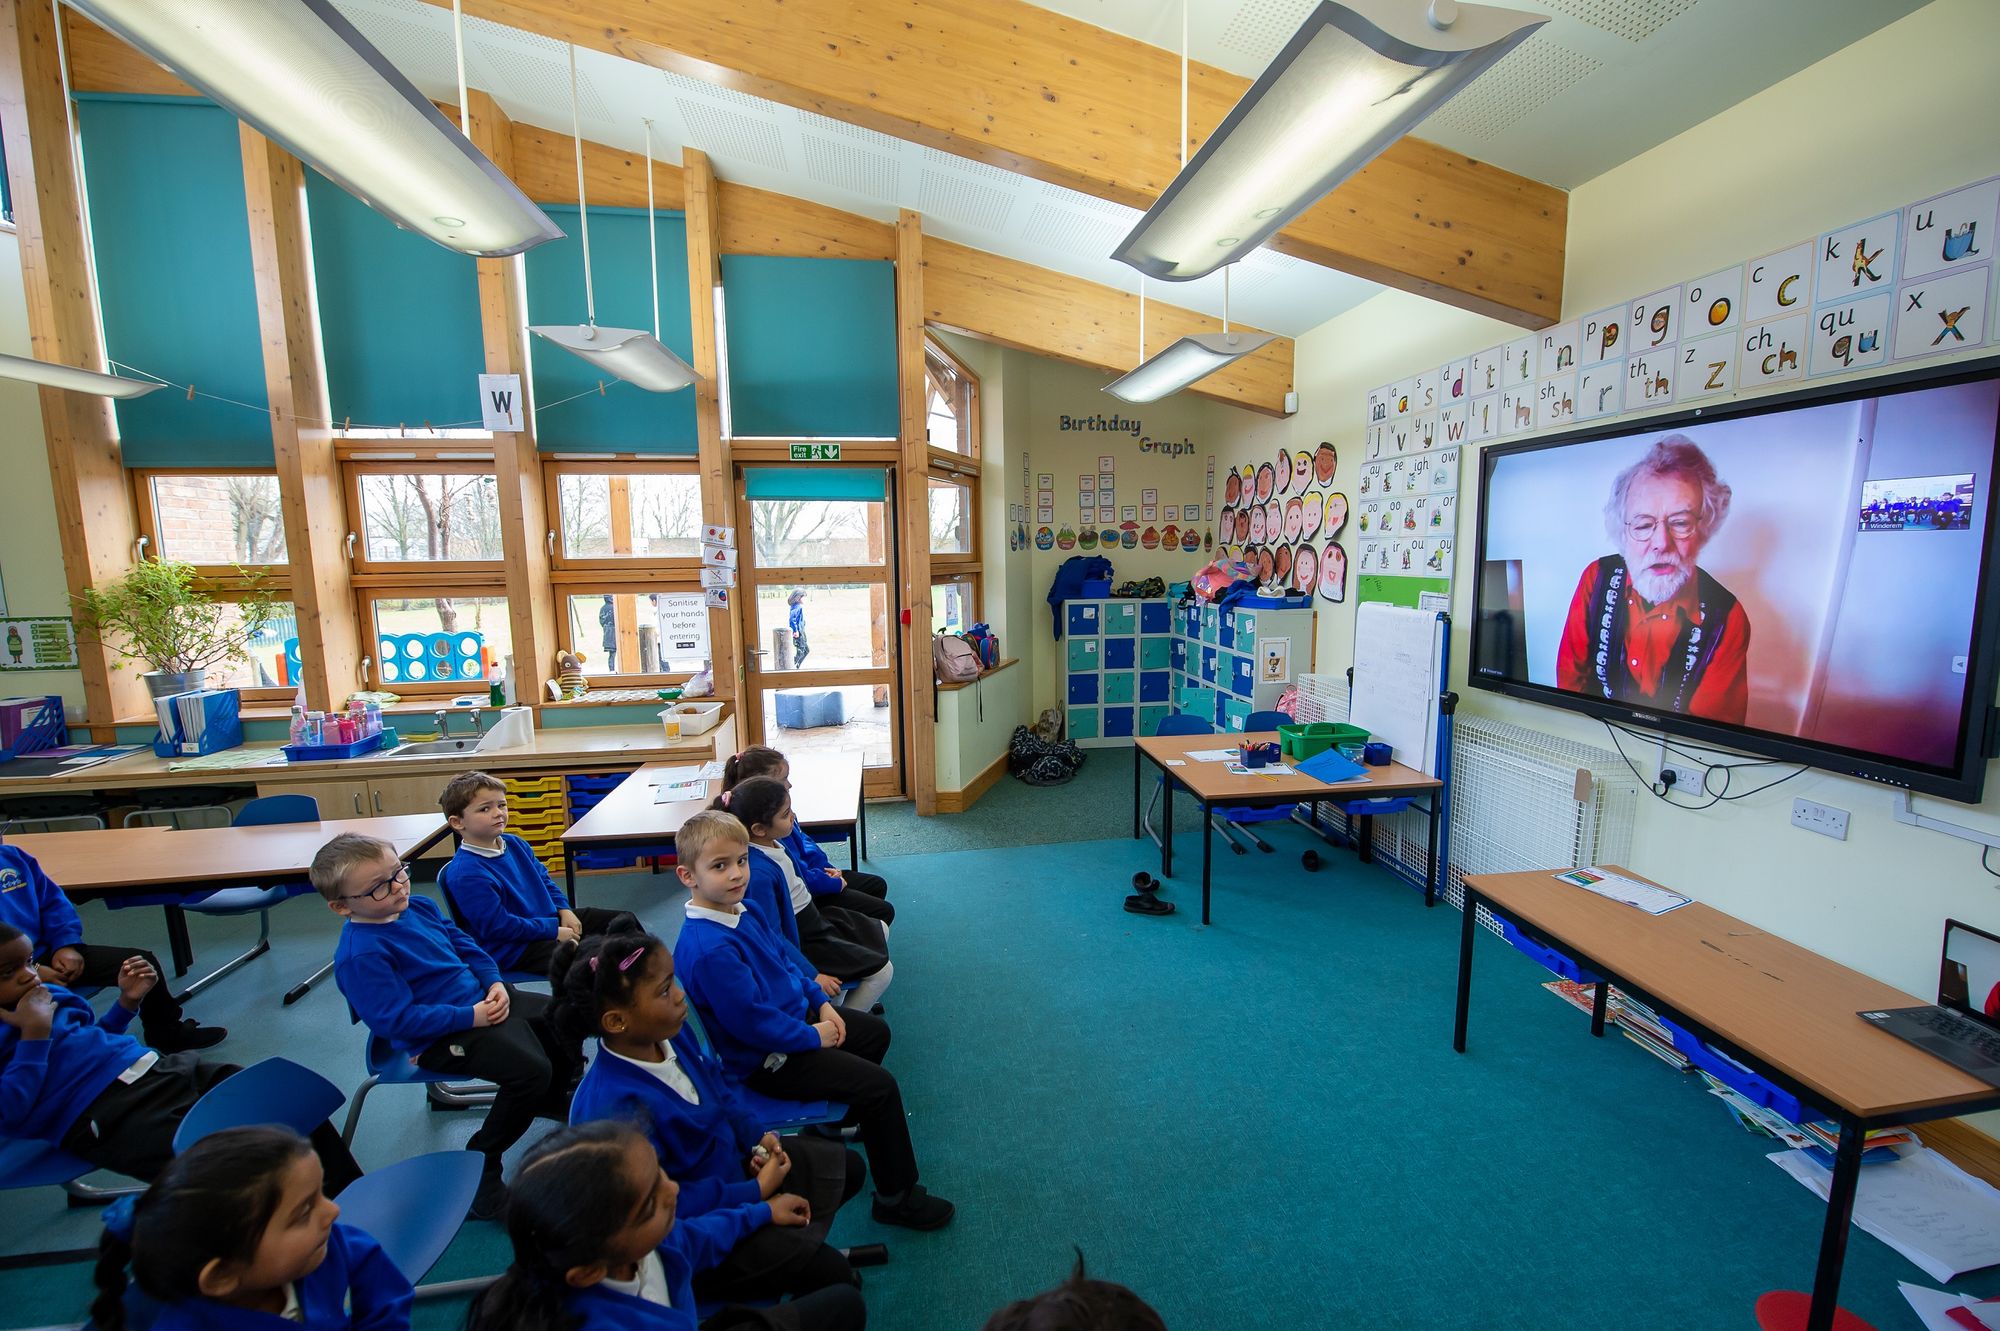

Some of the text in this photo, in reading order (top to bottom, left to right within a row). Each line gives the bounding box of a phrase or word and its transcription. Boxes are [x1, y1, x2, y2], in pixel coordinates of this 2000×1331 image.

[1916, 210, 1934, 231] u
[1826, 237, 1840, 261] k
[1942, 221, 1979, 261] u
[1852, 238, 1884, 287] k
[1752, 266, 1764, 283] c
[1690, 288, 1702, 303] o
[1777, 274, 1800, 306] c
[1906, 291, 1925, 312] x
[1634, 306, 1644, 326] g
[1708, 297, 1731, 326] o
[1587, 322, 1596, 341] p
[1651, 305, 1670, 346] g
[1820, 308, 1855, 336] qu
[1930, 306, 1970, 346] x
[1544, 335, 1553, 349] n
[1600, 323, 1619, 360] p
[1747, 327, 1772, 351] ch
[1832, 330, 1880, 367] qu
[1557, 345, 1574, 371] n
[1685, 349, 1695, 363] z
[1762, 342, 1798, 374] ch
[1444, 366, 1450, 381] d
[1630, 358, 1648, 378] th
[1704, 361, 1727, 390] z
[1452, 368, 1464, 398] d
[1540, 381, 1555, 399] sh
[1583, 376, 1590, 389] r
[1645, 370, 1669, 398] th
[491, 391, 512, 413] W
[1370, 394, 1378, 405] m
[1392, 388, 1397, 397] a
[1425, 388, 1433, 406] s
[1503, 393, 1510, 408] h
[1599, 385, 1612, 412] r
[1373, 402, 1386, 421] m
[1515, 397, 1530, 428] h
[1552, 392, 1573, 418] sh
[1060, 414, 1141, 437] Birthday
[1416, 418, 1420, 432] y
[1442, 411, 1451, 421] w
[1391, 425, 1395, 433] v
[1423, 422, 1434, 448] y
[1448, 421, 1464, 441] w
[1139, 437, 1196, 459] Graph
[1373, 428, 1381, 459] j
[1397, 433, 1406, 451] v
[1394, 460, 1403, 471] ee
[1414, 456, 1429, 475] igh
[1441, 452, 1458, 463] ow
[1370, 465, 1380, 476] ay
[1368, 504, 1377, 513] oo
[1390, 501, 1400, 510] oo
[1416, 498, 1426, 508] ar
[1443, 496, 1454, 506] or
[1367, 543, 1377, 552] air
[1393, 540, 1400, 552] ir
[1412, 540, 1424, 550] ou
[1440, 539, 1452, 553] oy
